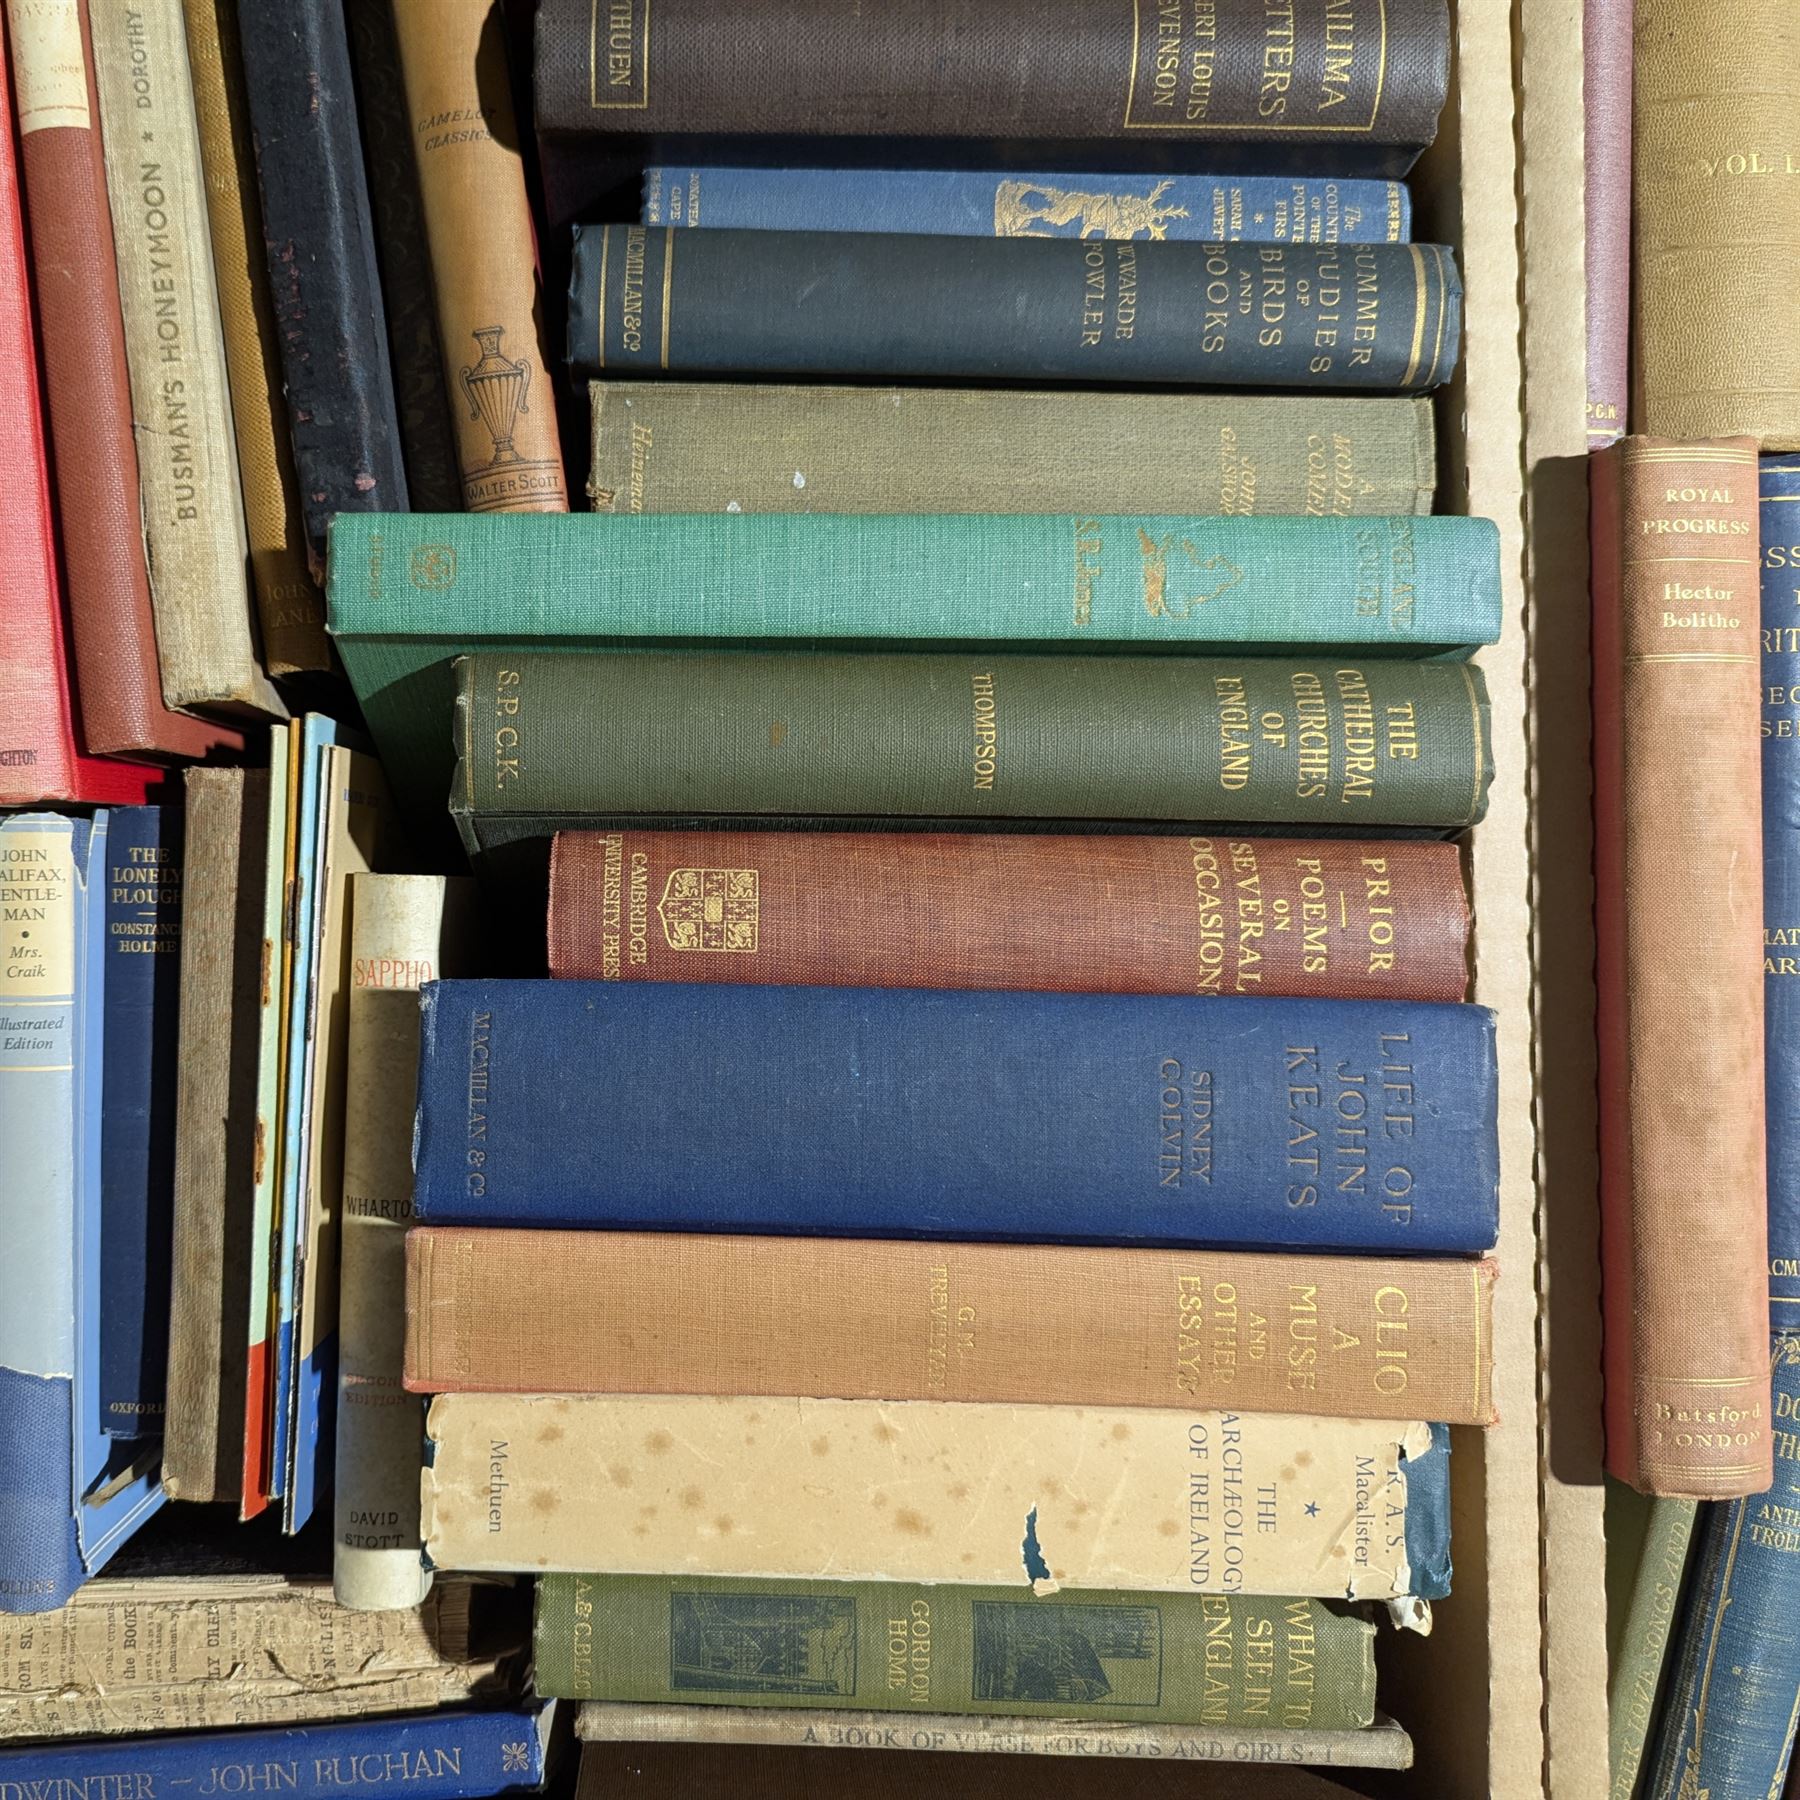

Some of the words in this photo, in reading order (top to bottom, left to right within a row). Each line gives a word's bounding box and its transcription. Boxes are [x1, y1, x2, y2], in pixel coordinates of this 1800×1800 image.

[124, 9, 152, 109] DOROTHY
[1187, 50, 1216, 120] LOUIS
[1259, 0, 1295, 117] TTERS
[425, 128, 493, 152] CLASSICS
[1699, 153, 1774, 176] VOL.
[670, 186, 682, 221] CAPE
[1213, 187, 1228, 242] JEWET
[1231, 188, 1243, 232] SARAH
[1274, 200, 1288, 239] FIRS
[1311, 197, 1322, 211] OF
[1325, 184, 1340, 243] COUNT
[1344, 207, 1361, 232] The
[141, 162, 185, 367] HONEYMOON
[1080, 241, 1106, 348] FOWLER
[1201, 243, 1230, 354] BOOKS
[1238, 270, 1253, 315] AND
[1258, 247, 1287, 348] BIRDS
[1296, 279, 1310, 307] OF
[1309, 246, 1341, 374] TUDIES
[1349, 242, 1379, 368] SUMMER
[162, 377, 198, 522] BUSMAN'S
[631, 421, 653, 513] Heinema
[1665, 488, 1735, 504] ROYAL
[1641, 519, 1751, 536] PROGRESS
[1663, 583, 1735, 601] Hector
[1662, 611, 1741, 629] Bolitho
[972, 672, 997, 792] THOMPSON
[1213, 675, 1253, 791] ENGLAND
[1260, 710, 1286, 749] OF
[1290, 672, 1329, 799] CHURCHES
[1335, 669, 1378, 803] CATHEDRAL
[1385, 702, 1418, 760] THE
[2, 849, 48, 863] JOHN
[112, 867, 183, 884] LONELY
[129, 847, 170, 862] THE
[603, 834, 623, 932] UNIVERSITY
[630, 851, 648, 966] CAMBRIDGE
[4, 907, 46, 921] MAN
[111, 923, 182, 936] CONSTANC
[1189, 837, 1223, 997] OCCASION
[1229, 841, 1266, 993] SEVERAL
[1273, 898, 1291, 932] ON
[1296, 858, 1329, 975] POEMS
[1361, 857, 1395, 975] PRIOR
[6, 964, 47, 979] Craik
[9, 945, 43, 960] Mrs.
[119, 940, 178, 953] HOLME
[354, 958, 433, 989] SAPPHO
[603, 932, 621, 982] PRES
[0, 1016, 65, 1032] llustrated
[4, 1037, 54, 1051] Edition
[467, 1011, 491, 1144] MACMILLAN
[1379, 1031, 1414, 1139] LIFE
[1160, 1058, 1185, 1190] COLVIN
[1190, 1070, 1213, 1185] SIDNEY
[1286, 1045, 1321, 1209] KEATS
[1336, 1061, 1368, 1195] JOHN
[467, 1149, 487, 1168] &
[1381, 1165, 1414, 1226] OF
[1177, 1274, 1202, 1396] ESSAYS
[1212, 1281, 1238, 1386] OTHER
[1250, 1311, 1267, 1360] AND
[1287, 1282, 1317, 1393] MUSE
[1331, 1325, 1362, 1355] A
[1372, 1285, 1410, 1396] CLIO
[345, 1372, 400, 1388] SECON
[346, 1391, 408, 1406] EDITION
[1188, 1423, 1209, 1460] OF
[1655, 1430, 1761, 1448] LONDON
[488, 1439, 510, 1535] Methuen
[1257, 1481, 1278, 1535] THE
[1385, 1469, 1402, 1495] R.
[350, 1511, 399, 1526] DAVID
[1189, 1472, 1211, 1586] IRELAND
[1355, 1454, 1377, 1568] Macalister
[1384, 1502, 1405, 1528] A.
[345, 1533, 405, 1549] STOTT
[1384, 1534, 1405, 1555] S.
[1663, 1520, 1688, 1582] AND
[123, 1606, 137, 1651] BOOK
[1245, 1616, 1274, 1680] SEE
[1284, 1598, 1317, 1694] WHAT
[1641, 1580, 1673, 1664] SONGS
[123, 1656, 136, 1681] the
[888, 1618, 909, 1690] HOME
[910, 1599, 931, 1703] GORDON
[1244, 1686, 1272, 1716] IN
[1282, 1698, 1311, 1728] TO
[1627, 1670, 1656, 1734] LOVE
[200, 1761, 299, 1794] JOHN
[314, 1746, 463, 1787] BUCHAN
[800, 1726, 823, 1744] A
[829, 1727, 902, 1749] BOOK
[911, 1731, 948, 1750] OF
[1171, 1740, 1224, 1760] AND
[1233, 1741, 1307, 1763] GIRLS
